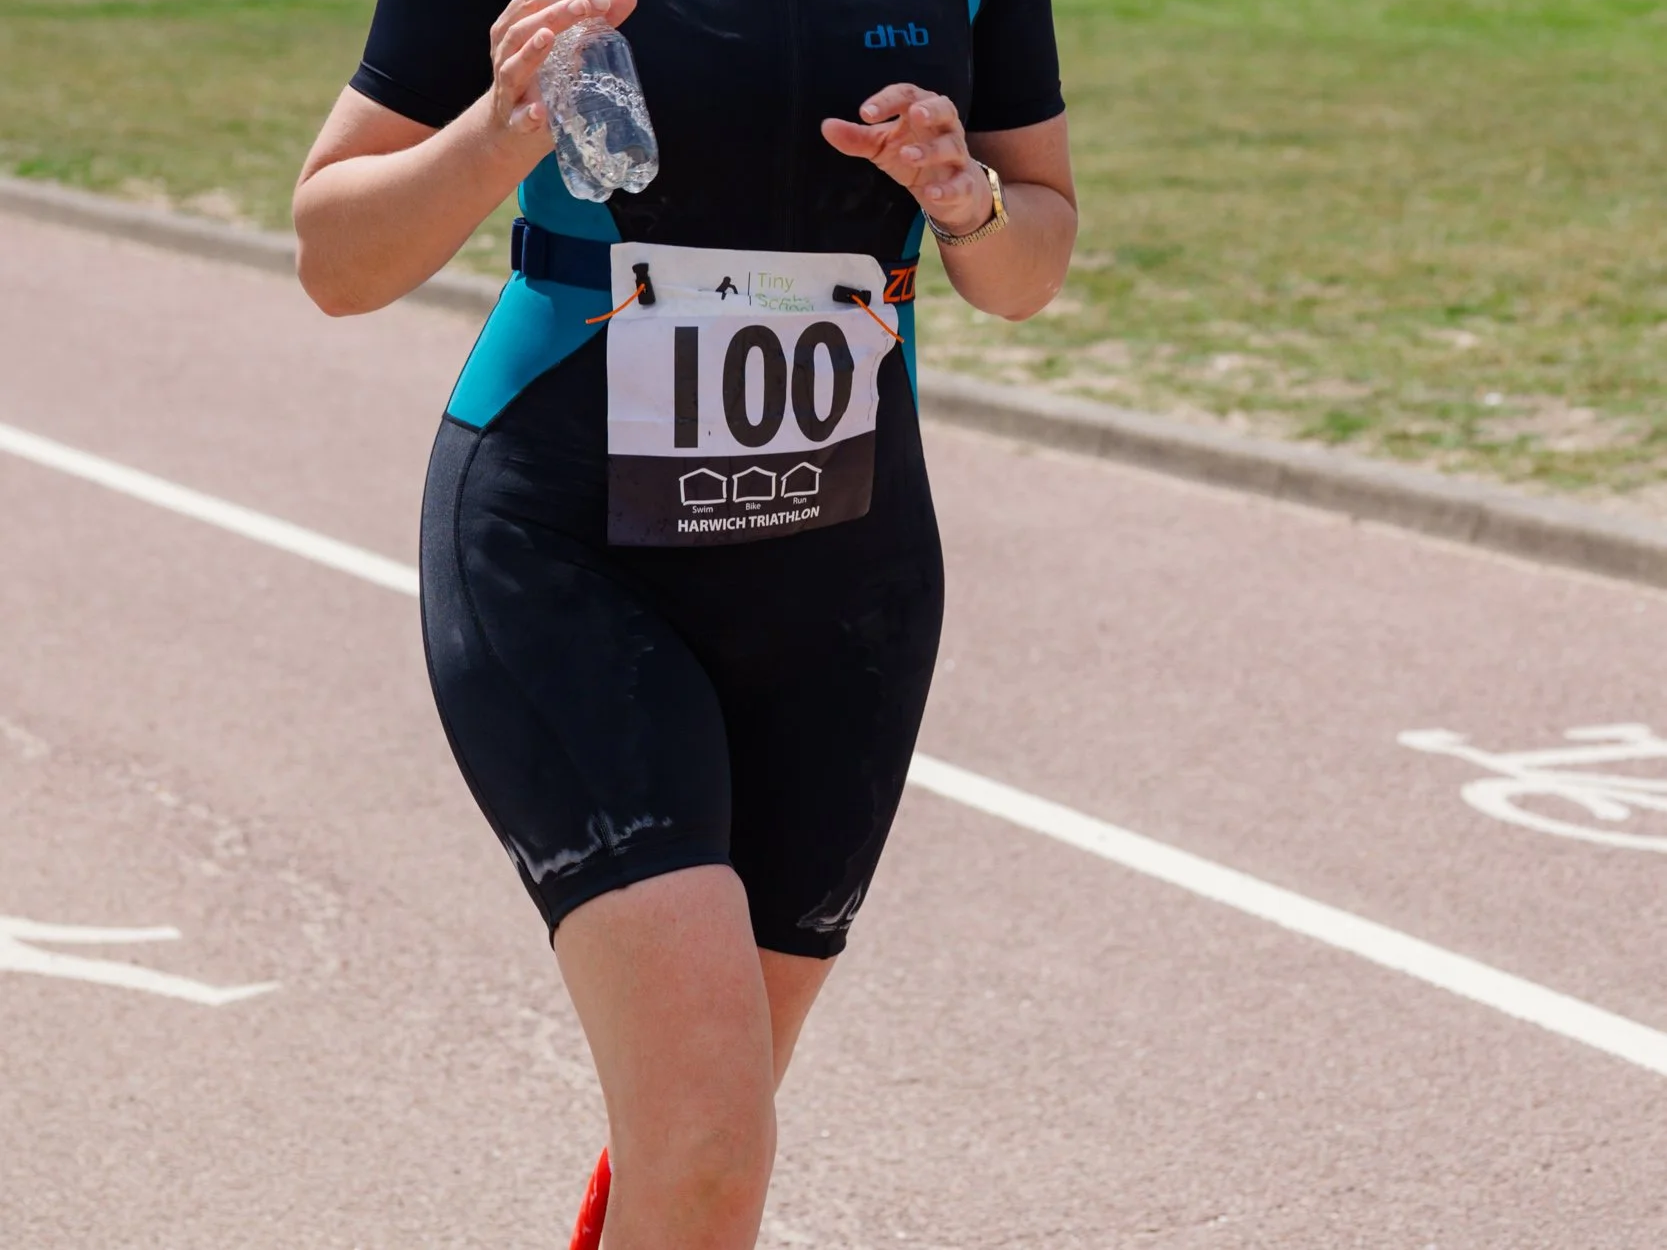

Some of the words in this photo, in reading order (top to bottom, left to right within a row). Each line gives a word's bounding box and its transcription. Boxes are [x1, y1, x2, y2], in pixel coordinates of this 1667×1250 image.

[865, 21, 929, 48] dhb
[757, 272, 795, 293] Tiny
[674, 321, 855, 449] 100
[677, 516, 746, 533] HARWICH
[748, 505, 821, 528] TRIATHLON
[692, 505, 714, 514] Swim
[745, 502, 762, 511] Bike
[792, 497, 807, 505] Run
